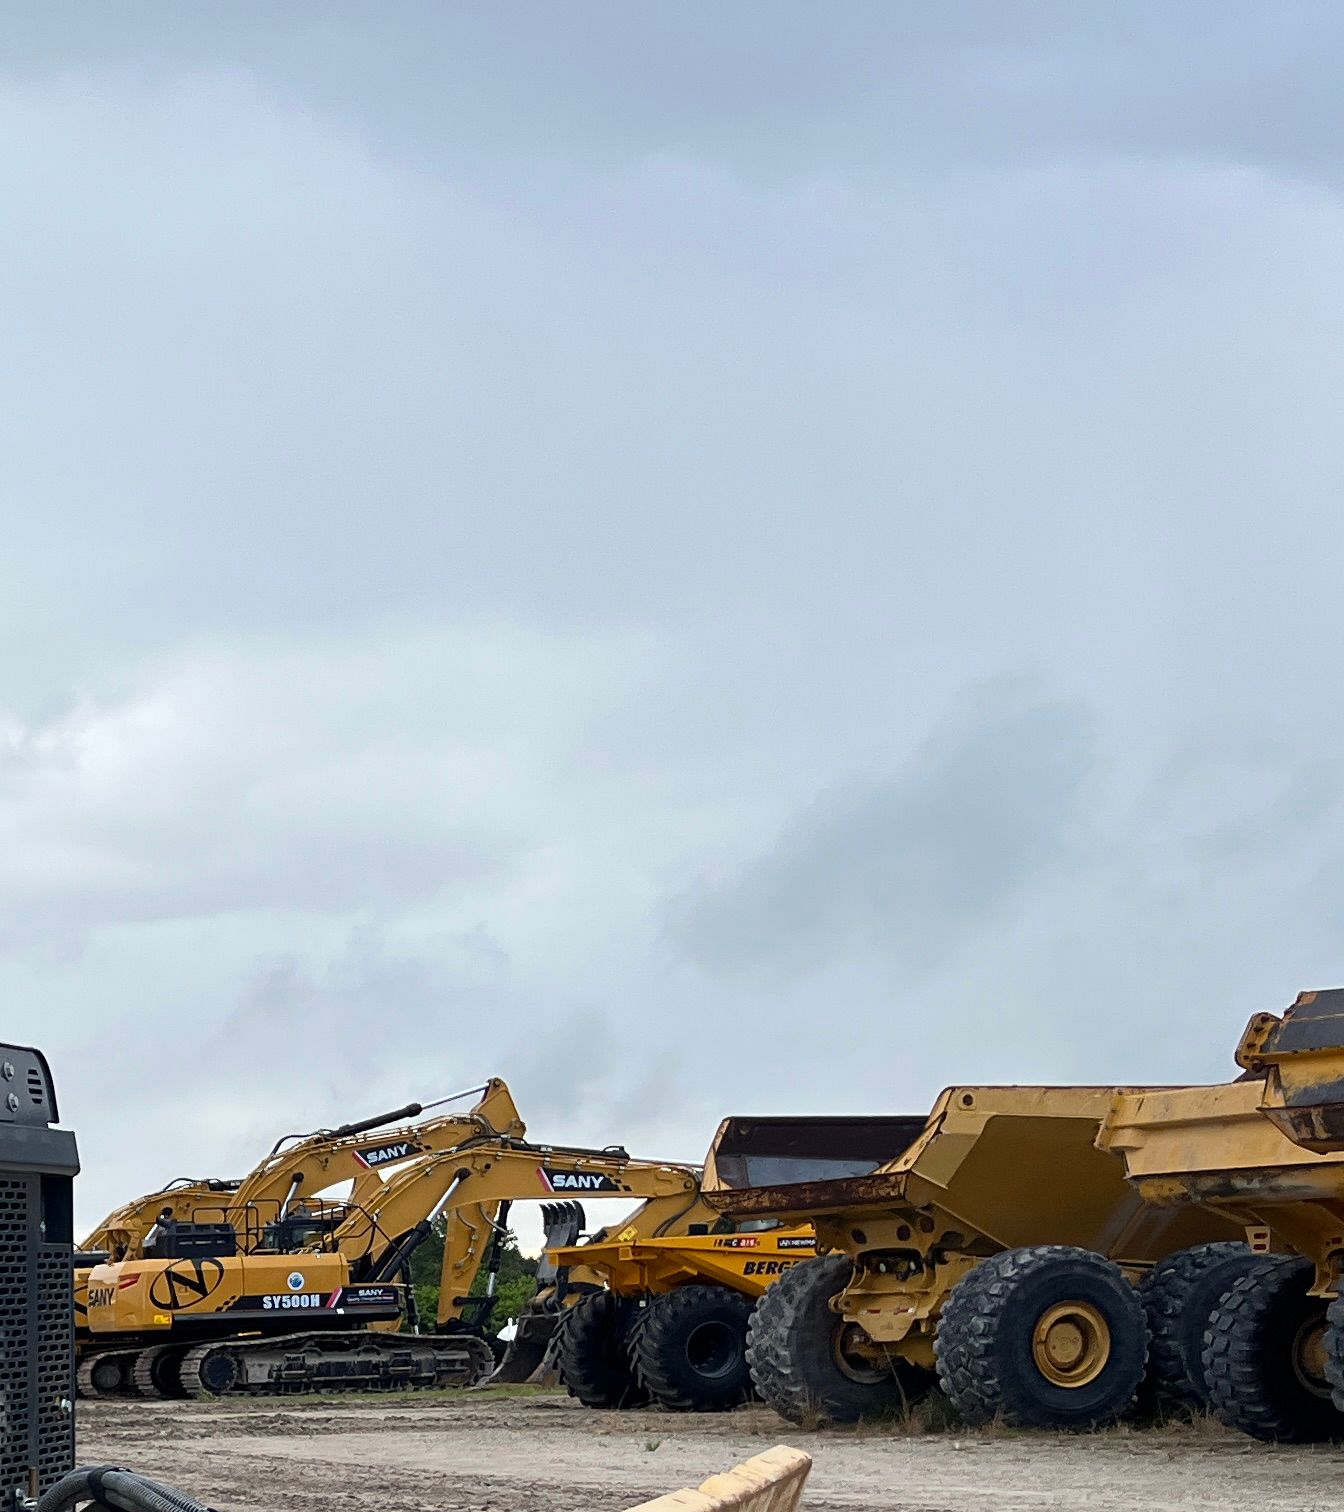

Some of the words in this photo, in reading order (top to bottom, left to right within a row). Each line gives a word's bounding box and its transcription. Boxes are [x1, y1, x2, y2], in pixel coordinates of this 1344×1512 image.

[366, 1143, 408, 1164] SANY
[552, 1174, 604, 1189] SANY
[743, 1260, 799, 1276] BERG
[263, 1294, 320, 1309] SY500H
